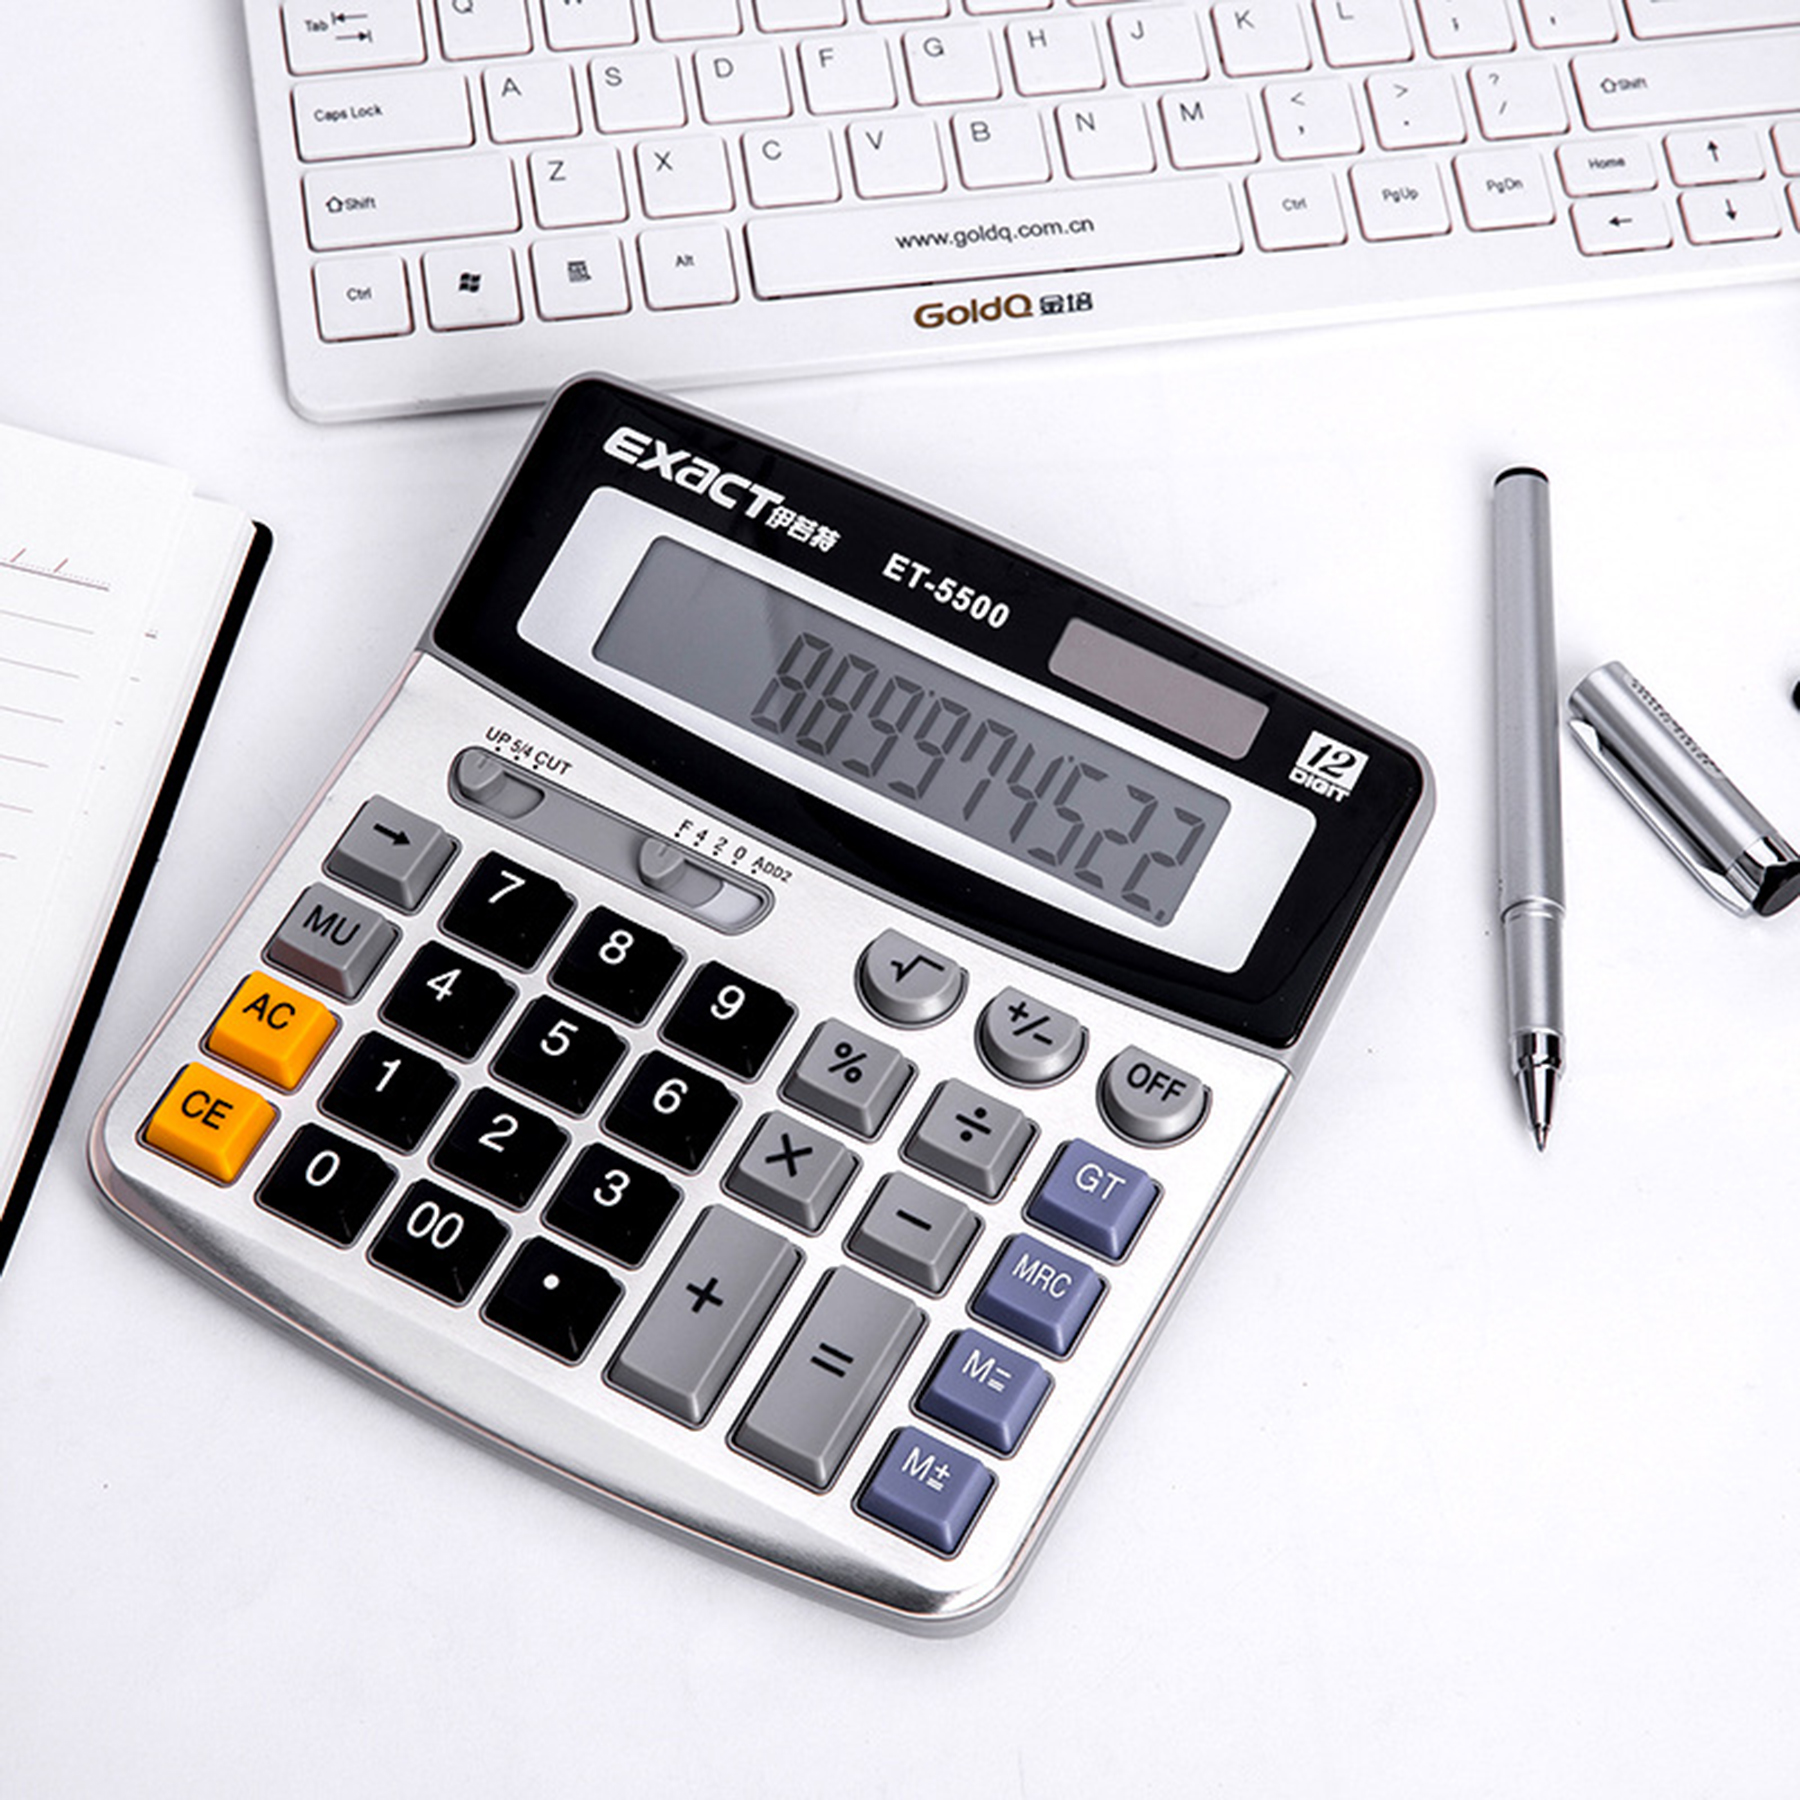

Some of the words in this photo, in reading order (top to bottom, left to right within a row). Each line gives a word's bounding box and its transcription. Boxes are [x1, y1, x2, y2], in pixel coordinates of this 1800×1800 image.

[1235, 10, 1253, 28] K
[1336, 2, 1353, 20] L
[305, 20, 328, 31] Tab
[1131, 21, 1144, 40] J
[923, 38, 944, 57] G
[1028, 30, 1046, 47] H
[714, 58, 733, 78] D
[819, 48, 832, 67] F
[502, 78, 521, 96] A
[605, 67, 622, 86] S
[314, 110, 347, 122] Caps
[351, 105, 382, 118] Lock
[1076, 113, 1095, 131] N
[1180, 102, 1203, 121] M
[866, 131, 883, 150] V
[970, 121, 990, 142] B
[762, 140, 781, 160] C
[549, 161, 565, 181] Z
[655, 152, 672, 171] X
[1589, 158, 1625, 169] Home
[1382, 188, 1418, 203] PgUp
[1486, 178, 1523, 194] PgDn
[345, 197, 376, 210] Shift
[1282, 198, 1307, 211] Ctrl
[896, 219, 1094, 248] www.goldq.com.cn
[676, 255, 694, 266] Alt
[347, 288, 371, 301] Ctrl
[914, 294, 1033, 328] GoldQ
[882, 553, 1010, 629] ET-5500
[486, 727, 511, 743] UP
[510, 739, 535, 757] 5/4
[535, 750, 572, 776] CUT
[1307, 744, 1357, 779] 12
[1288, 767, 1351, 803] DIGIT
[679, 820, 693, 831] F
[697, 830, 708, 841] 4
[714, 837, 728, 851] 2
[732, 846, 747, 862] 0
[751, 857, 793, 883] ADD2
[488, 870, 525, 904] 7
[303, 905, 360, 946] MU
[599, 930, 633, 964] 8
[427, 969, 461, 1000] 4
[243, 993, 295, 1030] AC
[711, 985, 745, 1019] 9
[541, 1020, 578, 1055] 5
[376, 1060, 401, 1091] 1
[1127, 1063, 1186, 1101] OFF
[654, 1079, 687, 1113] 6
[181, 1090, 233, 1130] CE
[479, 1114, 518, 1152] 2
[306, 1151, 340, 1186] 0
[594, 1170, 630, 1206] 3
[1075, 1163, 1126, 1201] GT
[407, 1202, 464, 1248] 00
[1012, 1253, 1072, 1299] MRC
